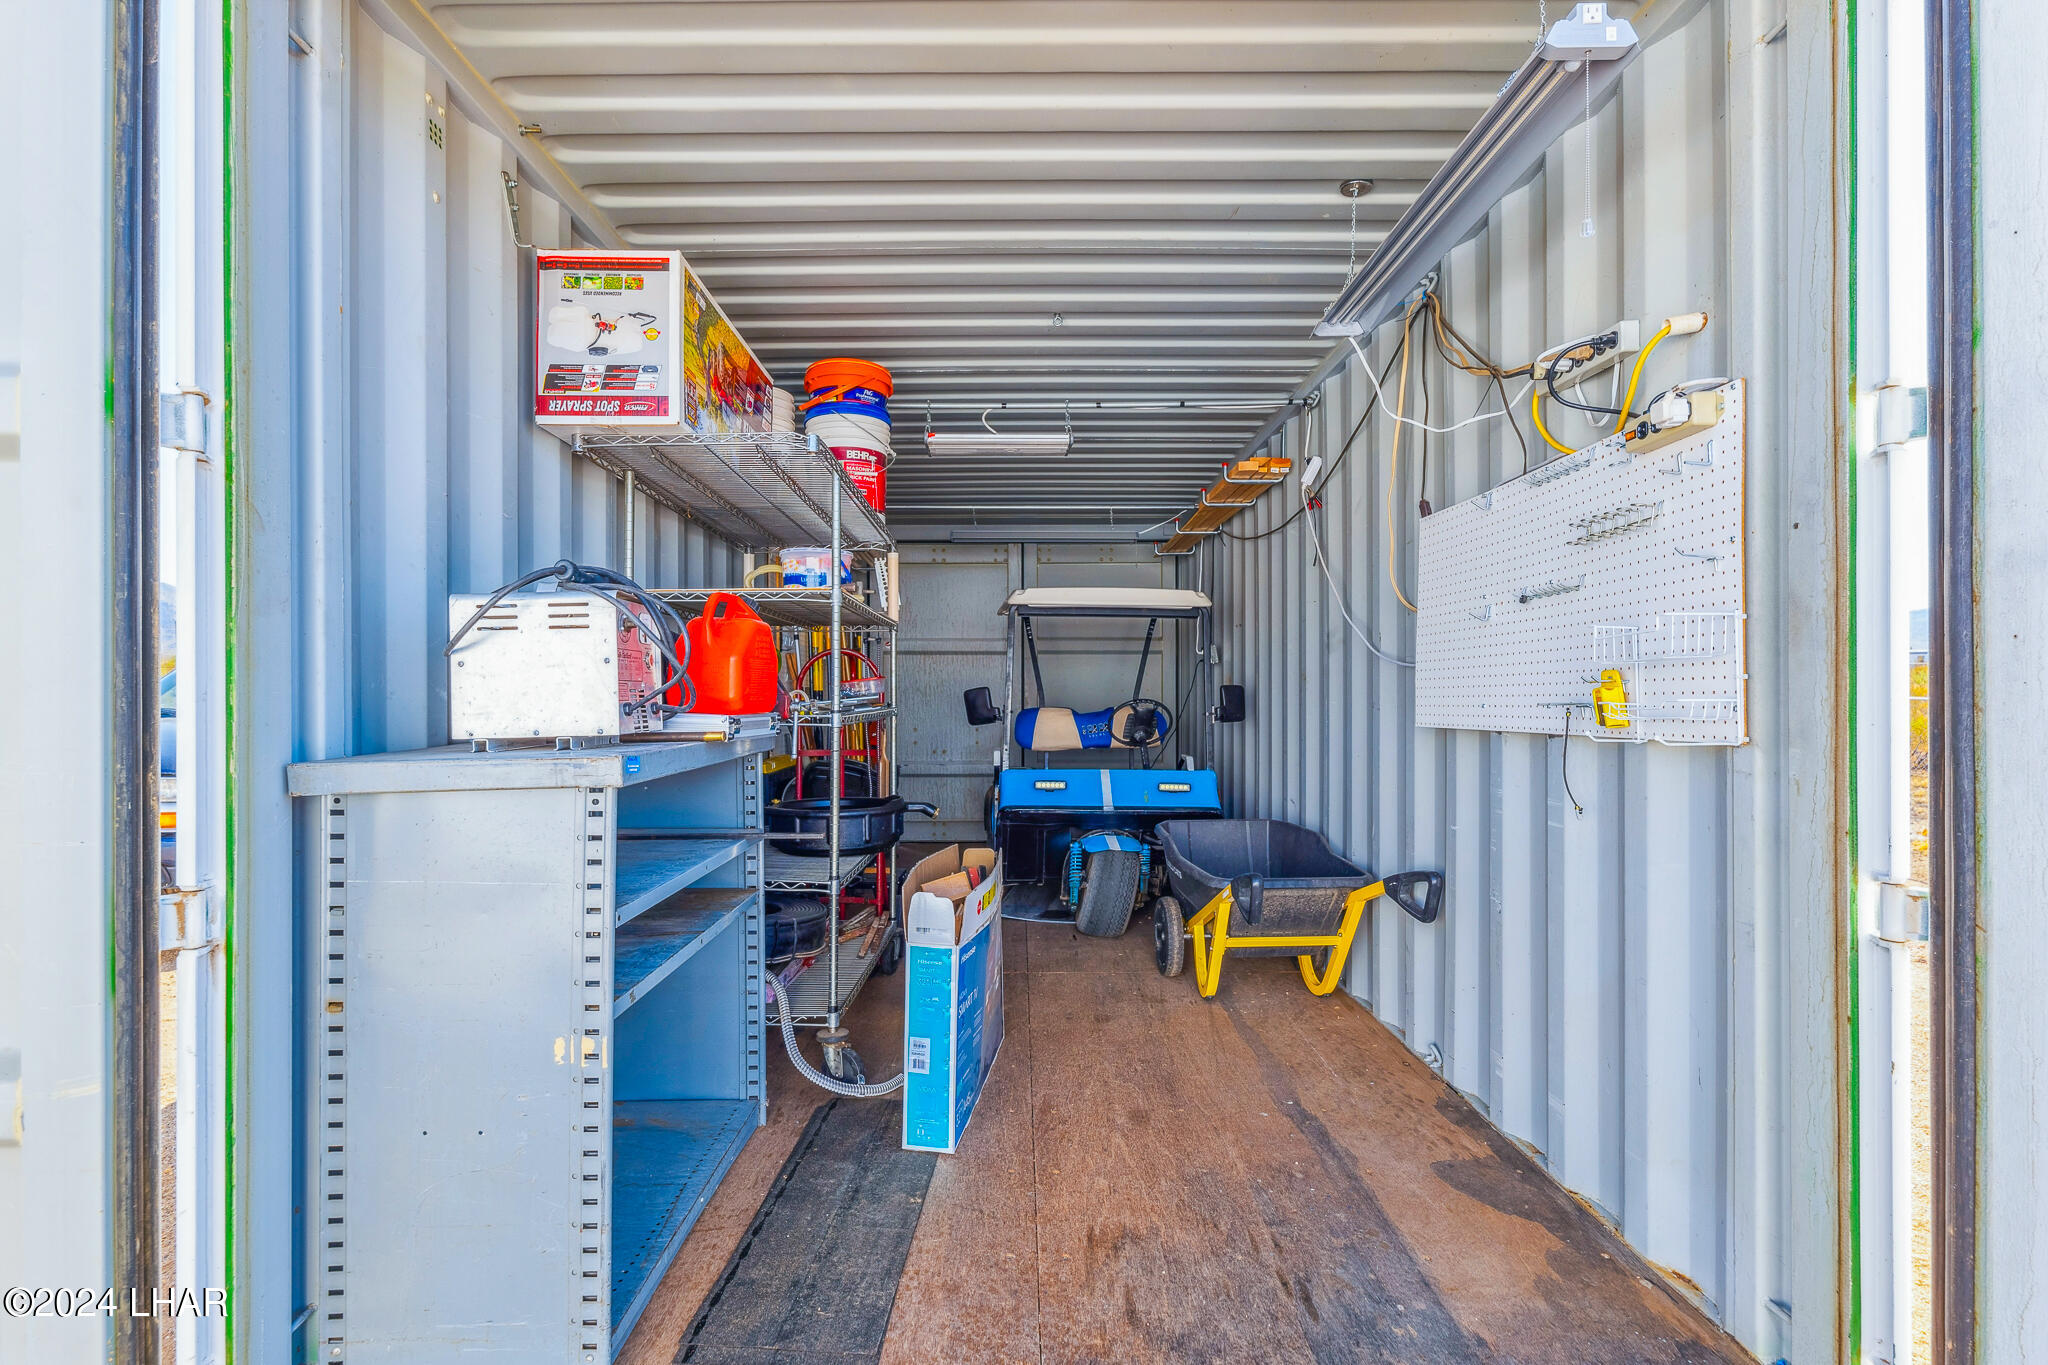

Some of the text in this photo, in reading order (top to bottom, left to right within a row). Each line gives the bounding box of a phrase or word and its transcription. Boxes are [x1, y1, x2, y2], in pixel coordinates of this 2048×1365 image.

[548, 400, 593, 412] SPRAYER
[594, 400, 621, 412] SPOT
[846, 450, 870, 460] BEHR
[960, 945, 976, 965] Hisense
[958, 991, 974, 1018] SMART
